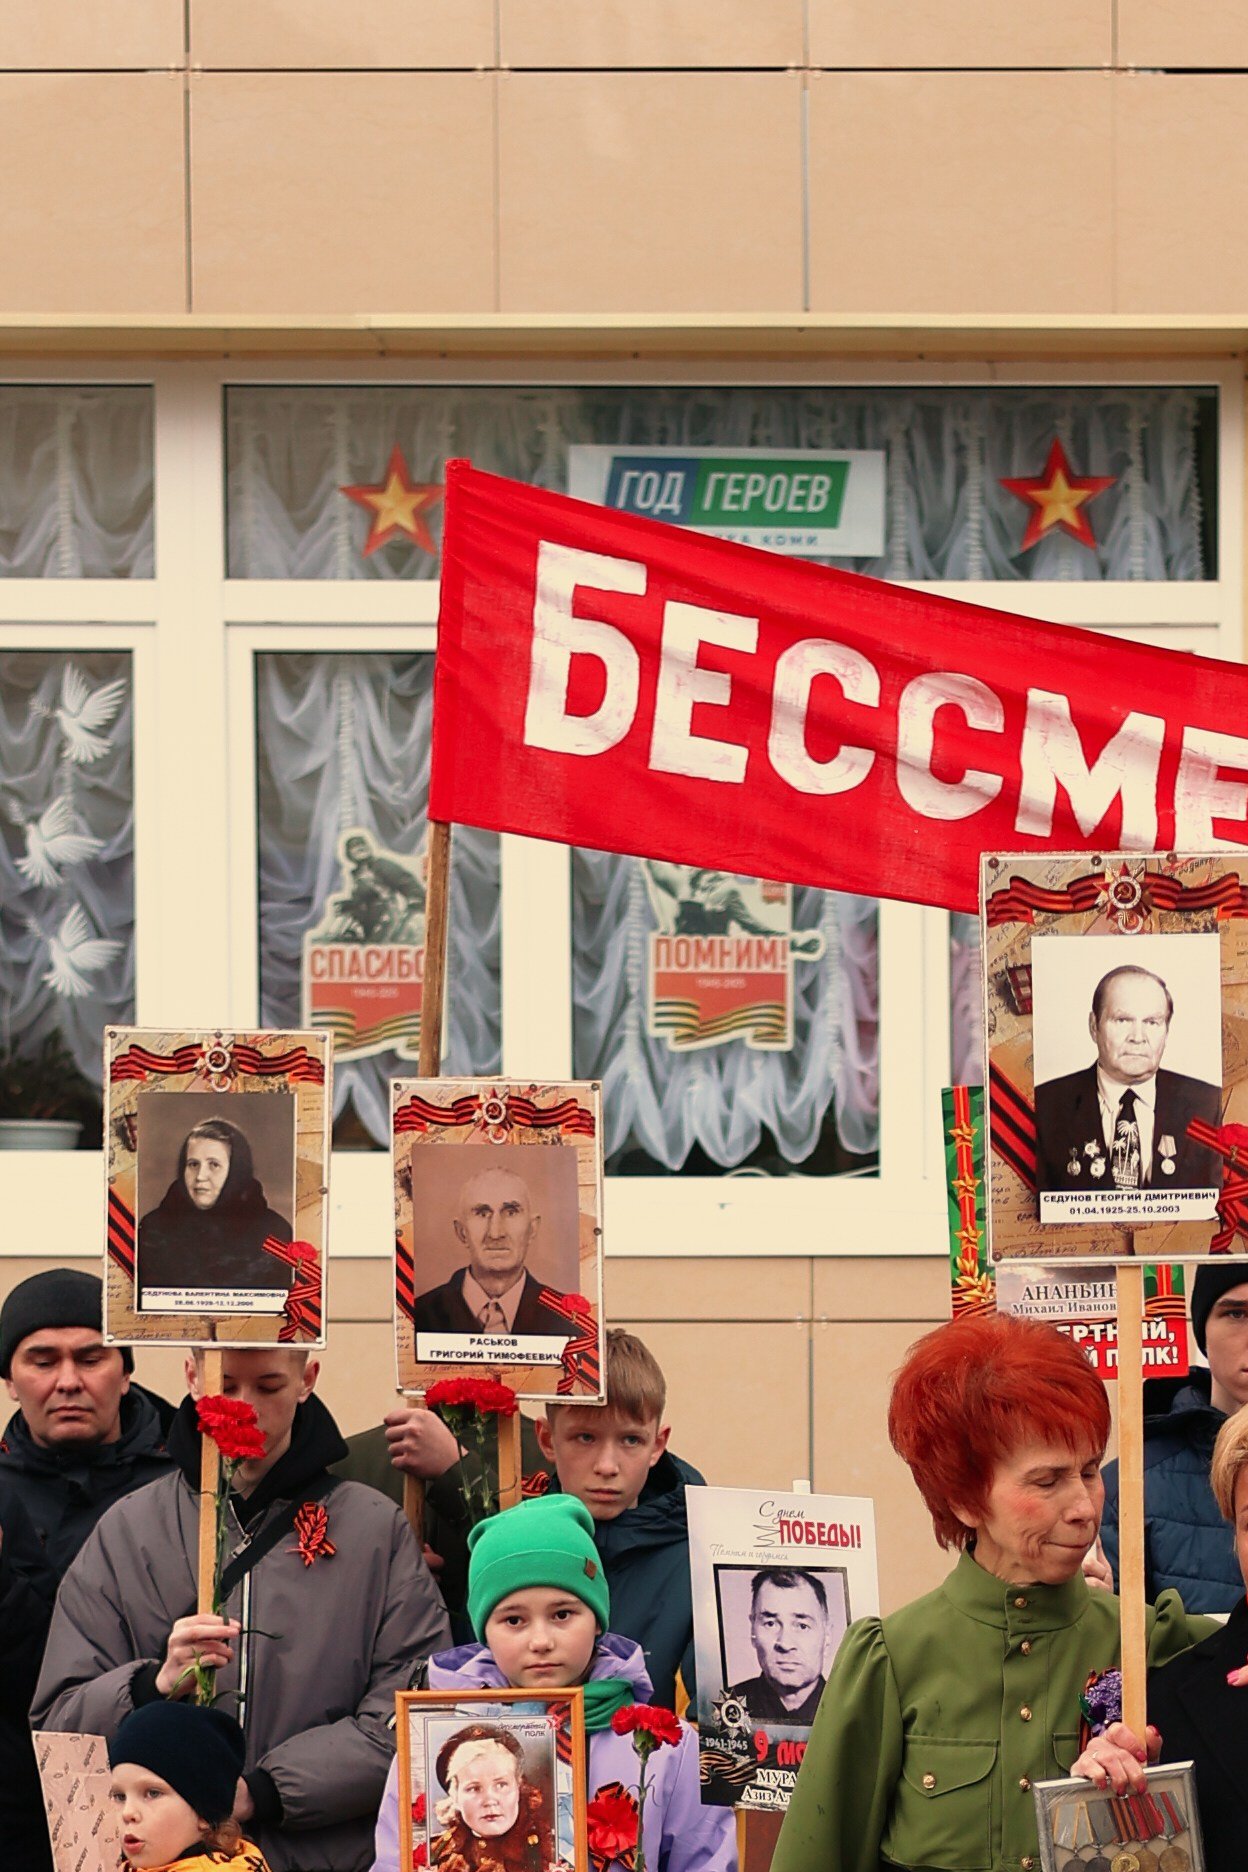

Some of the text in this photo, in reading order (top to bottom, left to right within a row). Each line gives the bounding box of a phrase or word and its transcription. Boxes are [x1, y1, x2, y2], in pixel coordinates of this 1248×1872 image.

[616, 471, 832, 516] ГОД ГЕРОЕВ
[1043, 1192, 1216, 1203] СЕДУНОВ ГЕОРГИЙ ДМИТРИЕВИЧ
[1069, 1205, 1181, 1215] 01.04.1925-25.10.2003
[1012, 1302, 1118, 1315] Михаил Иванов
[469, 1338, 518, 1347] РАСЬКОВ
[430, 1350, 561, 1361] ГРИГОРИЙ ТИМОФЕЕВИЧ
[779, 1519, 862, 1549] ПОБЕДЫ!
[705, 1737, 748, 1750] 1941-1945
[753, 1729, 769, 1762] 9
